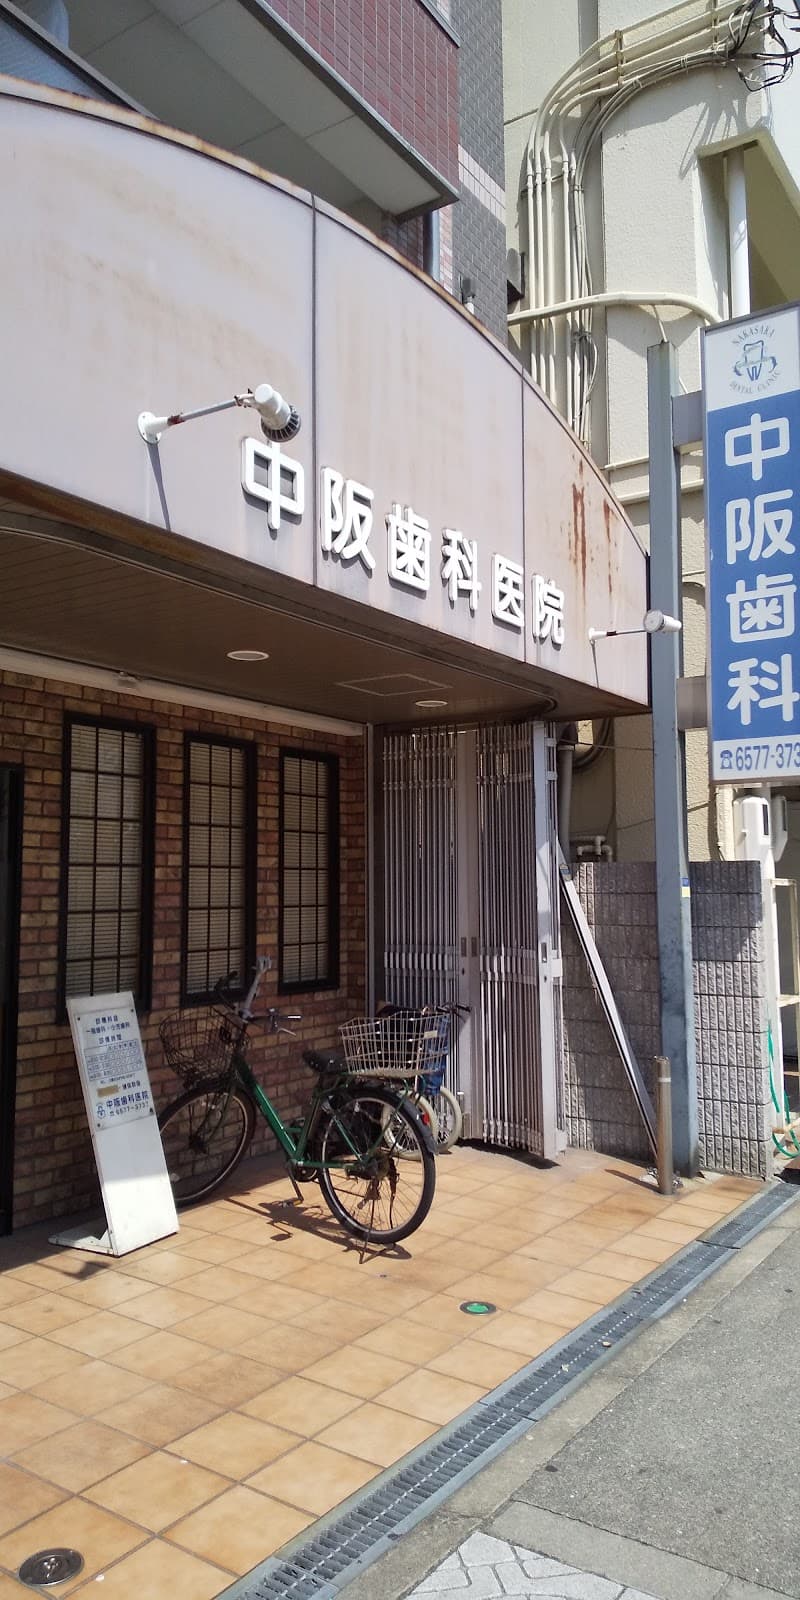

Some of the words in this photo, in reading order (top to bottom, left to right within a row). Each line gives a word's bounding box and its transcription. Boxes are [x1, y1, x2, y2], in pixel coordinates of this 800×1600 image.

[241, 437, 565, 646] 中阪歯科医院
[724, 412, 800, 726] 中阪歯科
[106, 1090, 149, 1109] 中阪歯科医院
